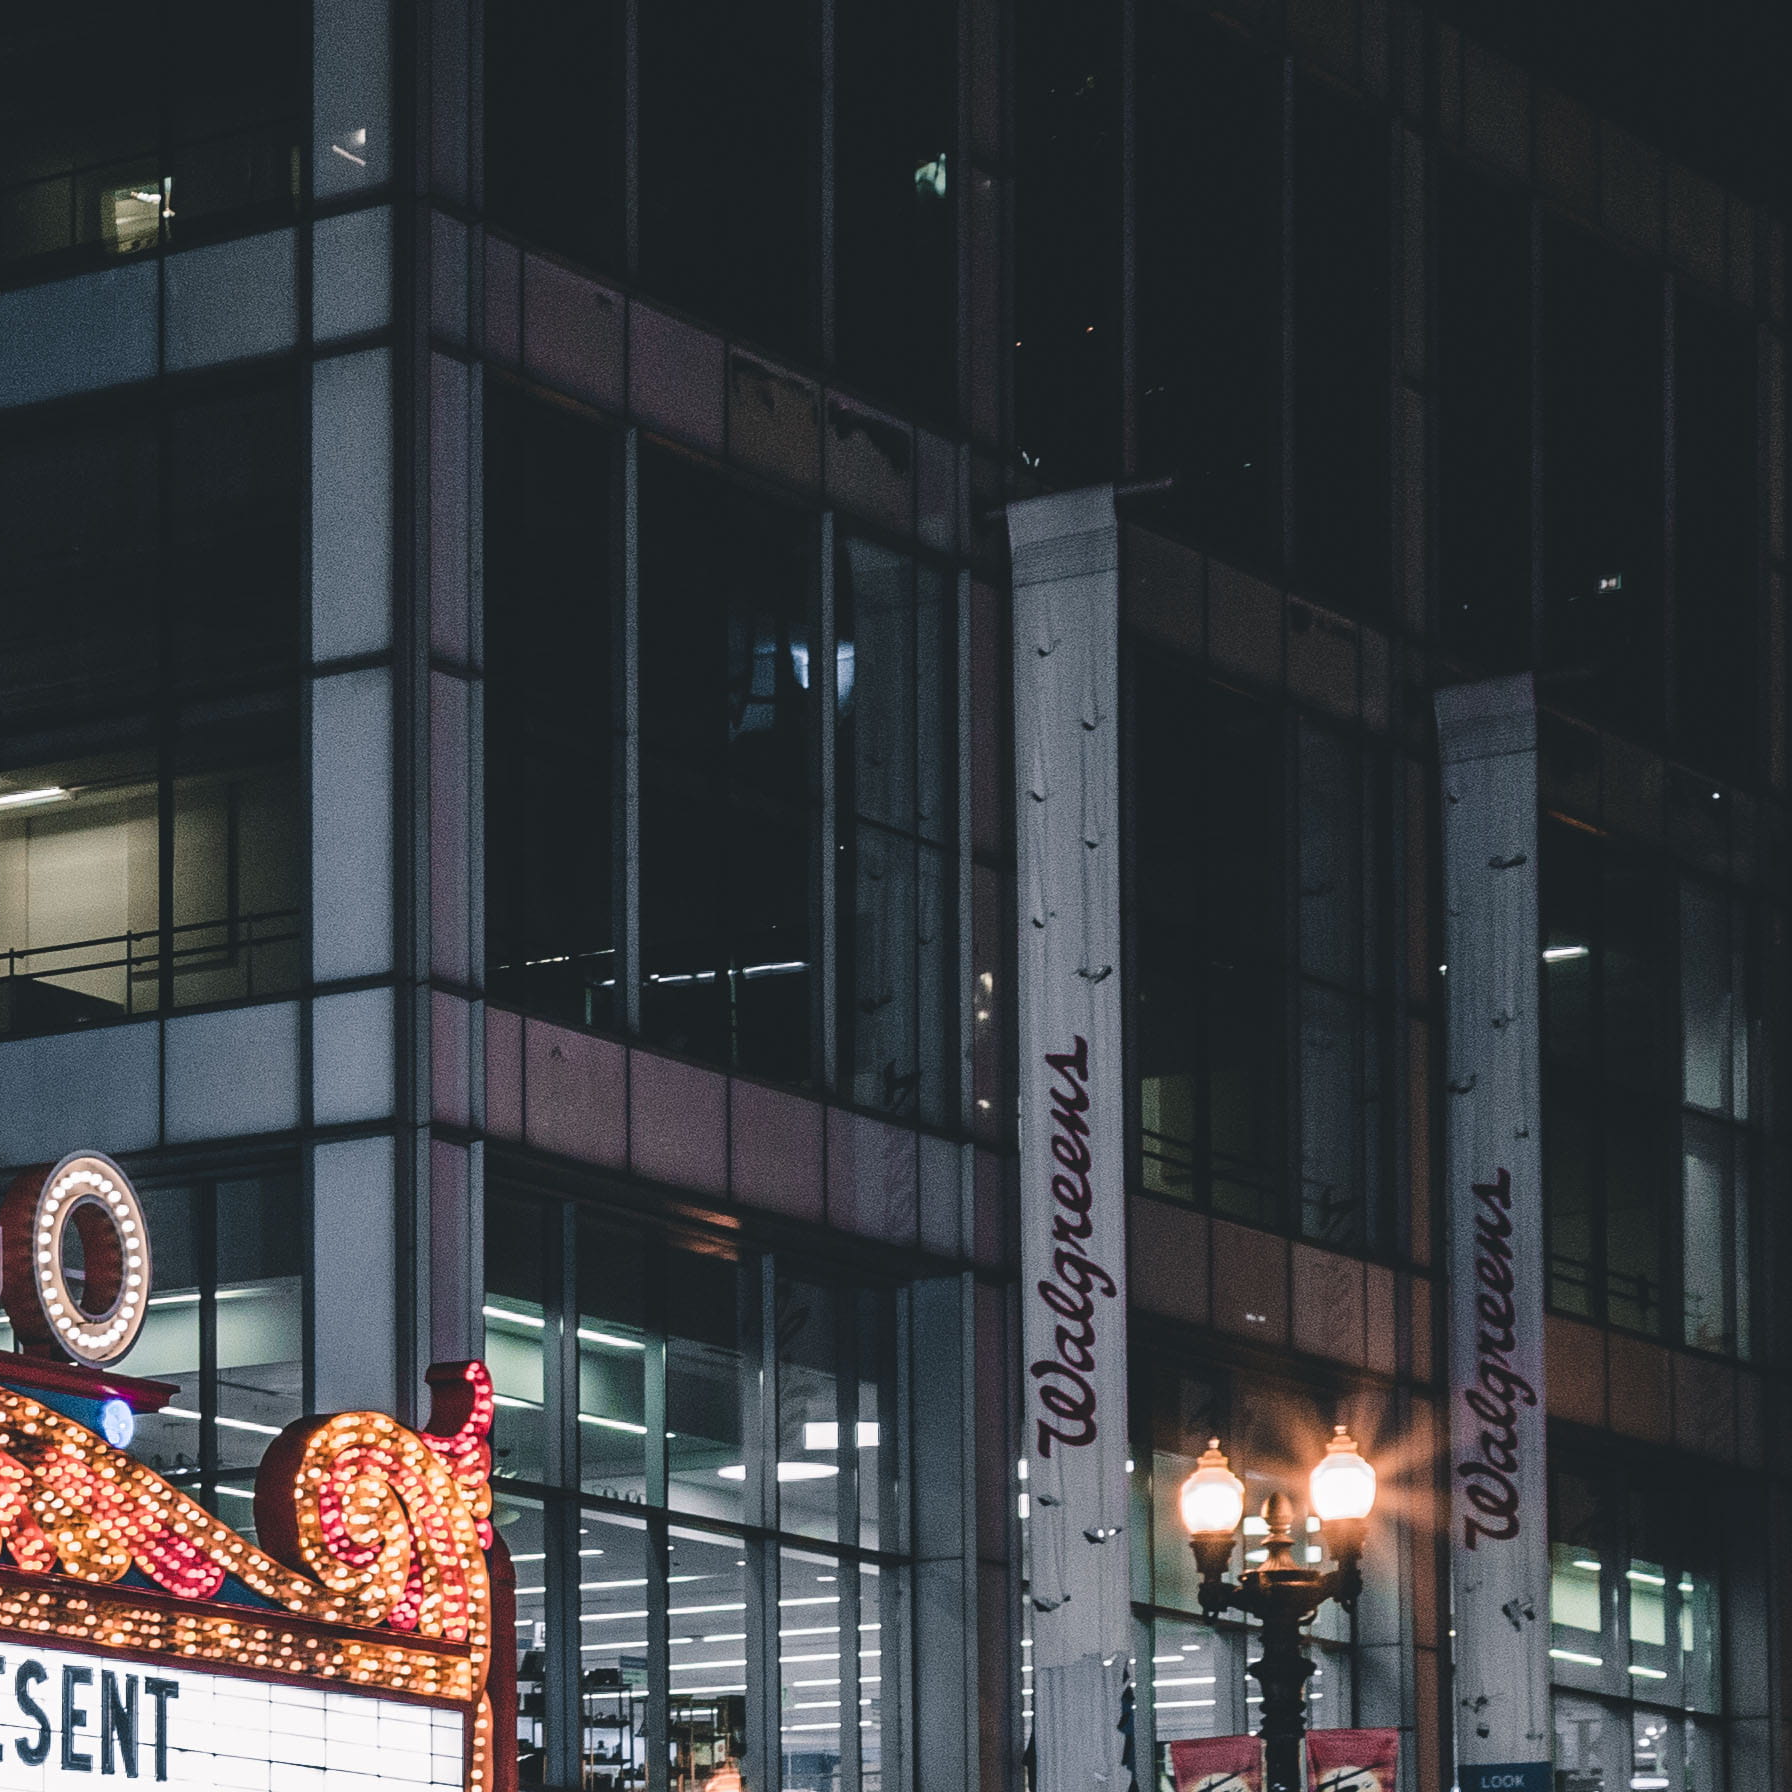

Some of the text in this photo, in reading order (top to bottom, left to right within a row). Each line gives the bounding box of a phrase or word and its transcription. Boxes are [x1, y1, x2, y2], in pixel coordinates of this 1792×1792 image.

[1032, 1033, 1117, 1460] Walgreens
[1464, 1165, 1537, 1553] Walgreens
[1481, 1775, 1526, 1789] LOOK
